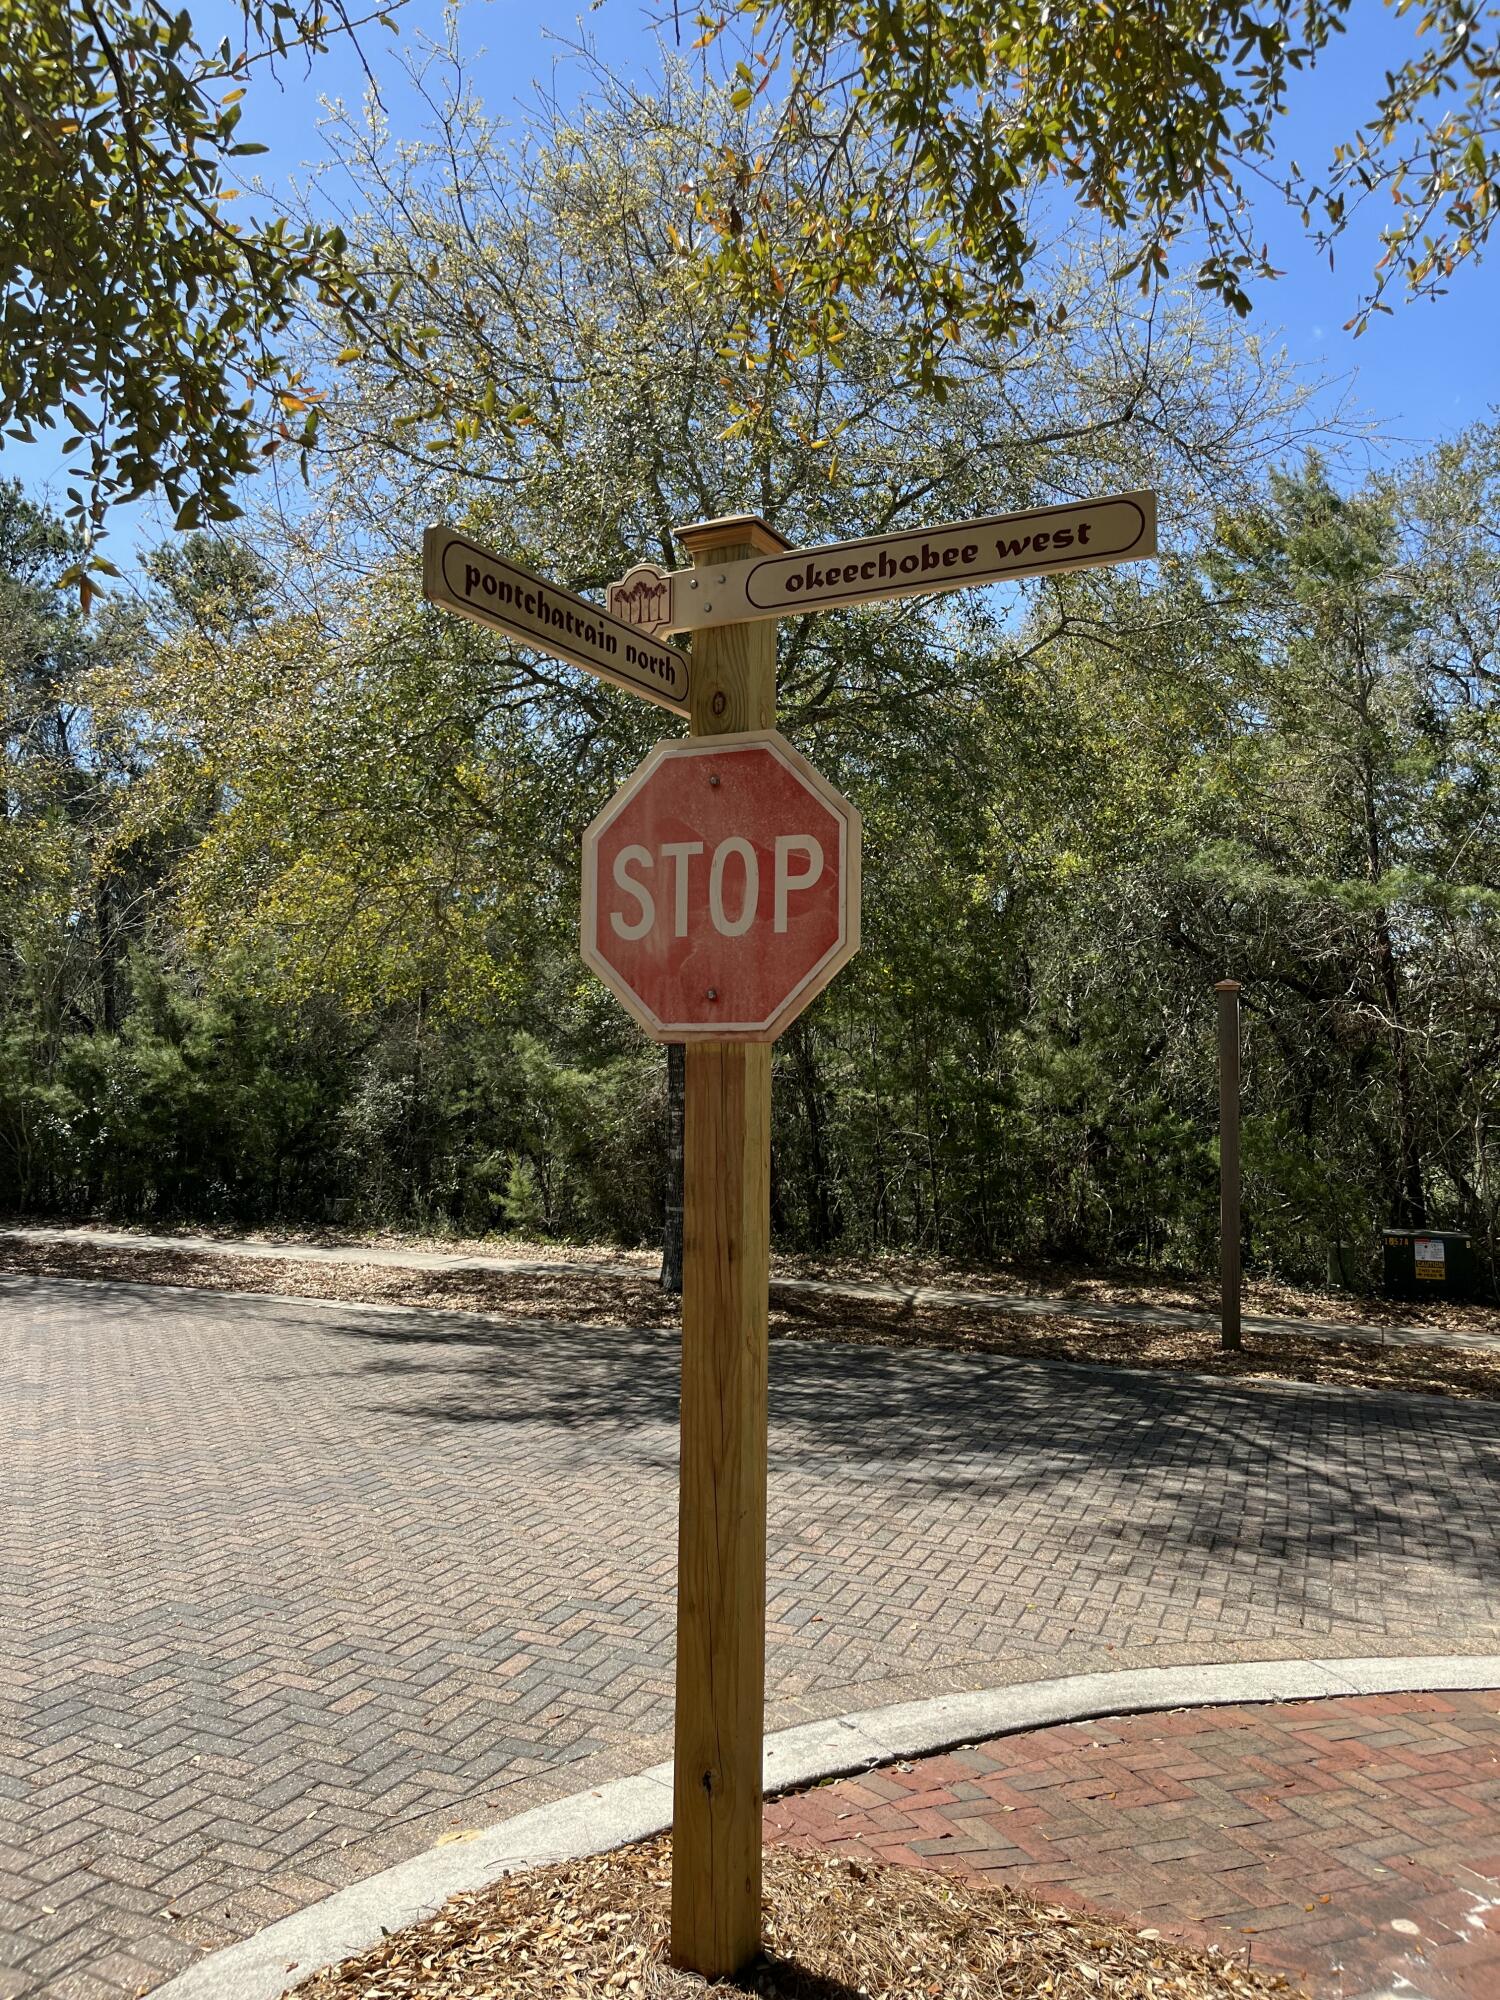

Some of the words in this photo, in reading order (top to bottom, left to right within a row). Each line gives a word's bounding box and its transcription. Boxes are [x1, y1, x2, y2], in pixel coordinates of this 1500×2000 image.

[785, 541, 978, 592] okeechobee
[995, 522, 1092, 559] west
[465, 563, 617, 655] pontchatrain
[626, 644, 676, 685] north
[610, 834, 824, 941] STOP
